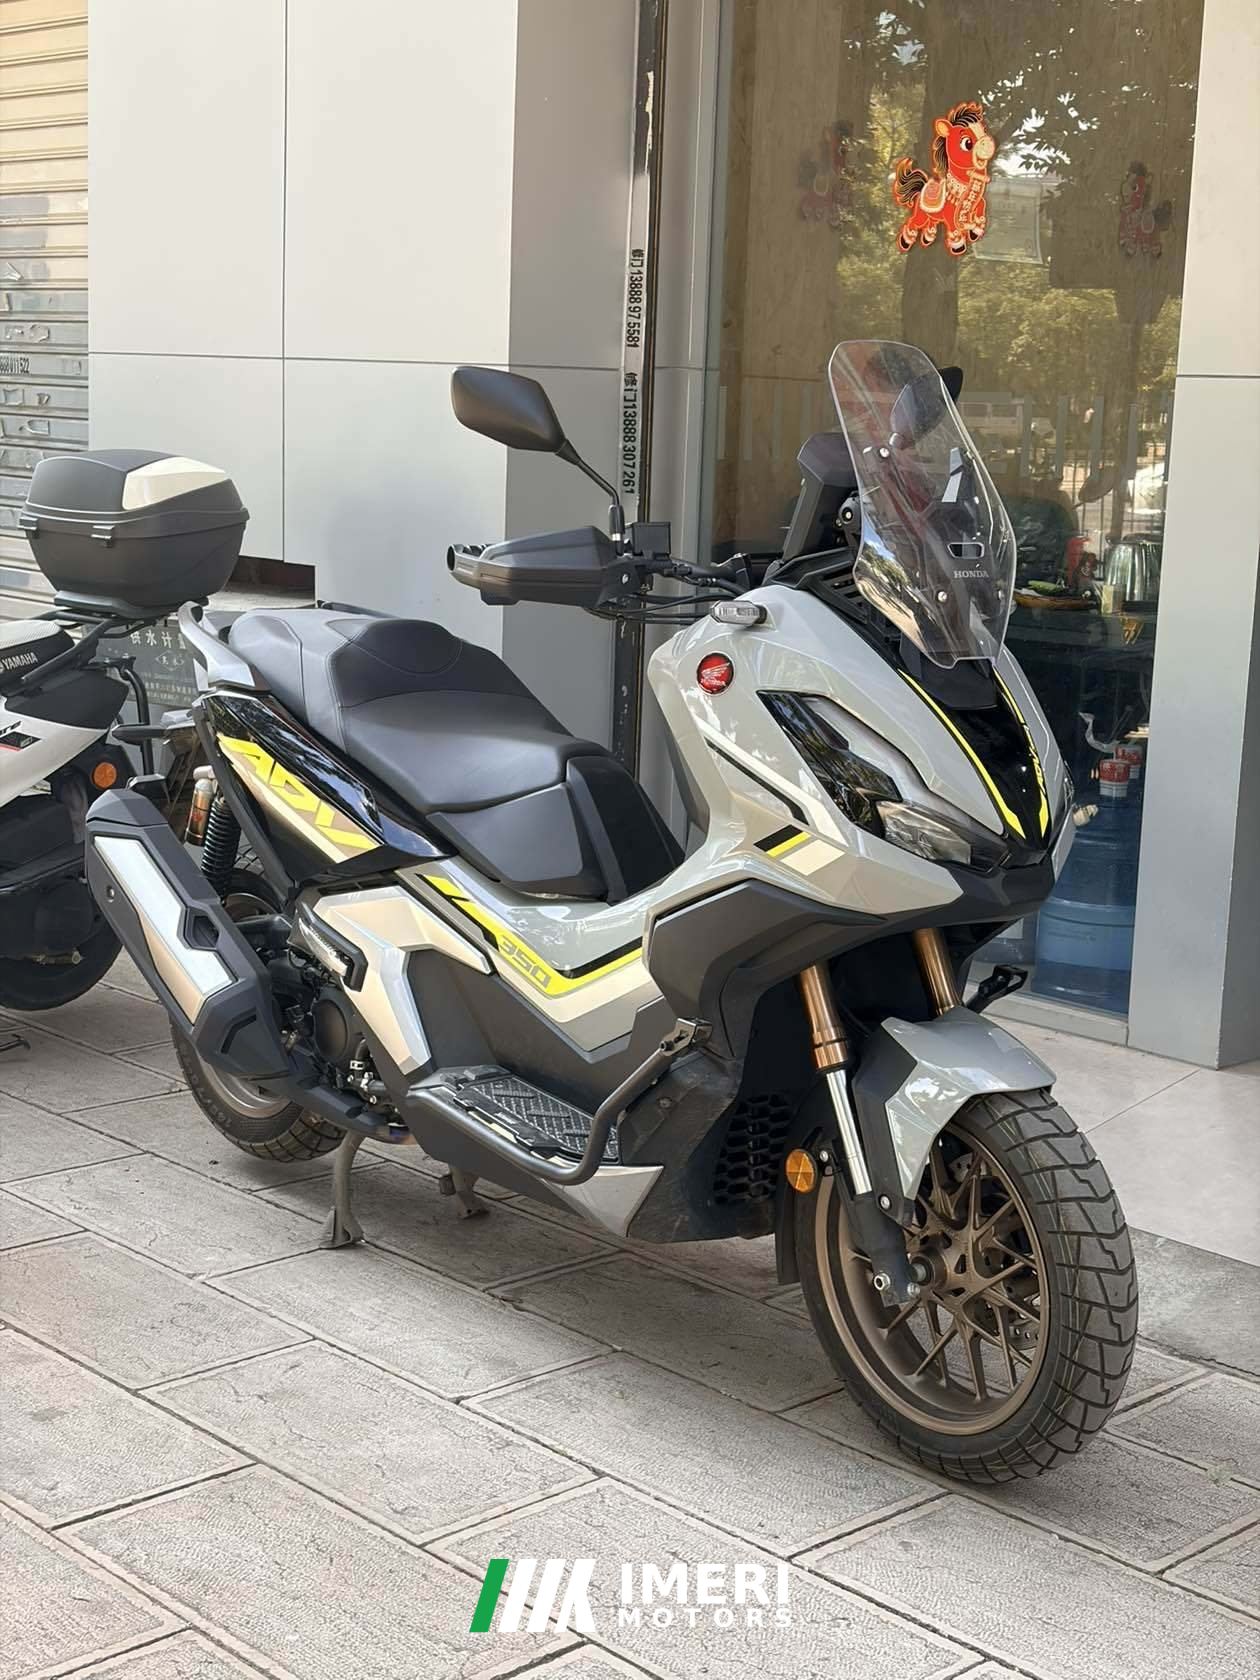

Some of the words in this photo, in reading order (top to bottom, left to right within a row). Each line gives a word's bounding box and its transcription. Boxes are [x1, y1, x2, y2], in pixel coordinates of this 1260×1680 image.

[953, 570, 989, 578] HONDA
[2, 652, 38, 671] YAMAHA
[216, 732, 381, 849] ADV
[499, 935, 552, 988] 350
